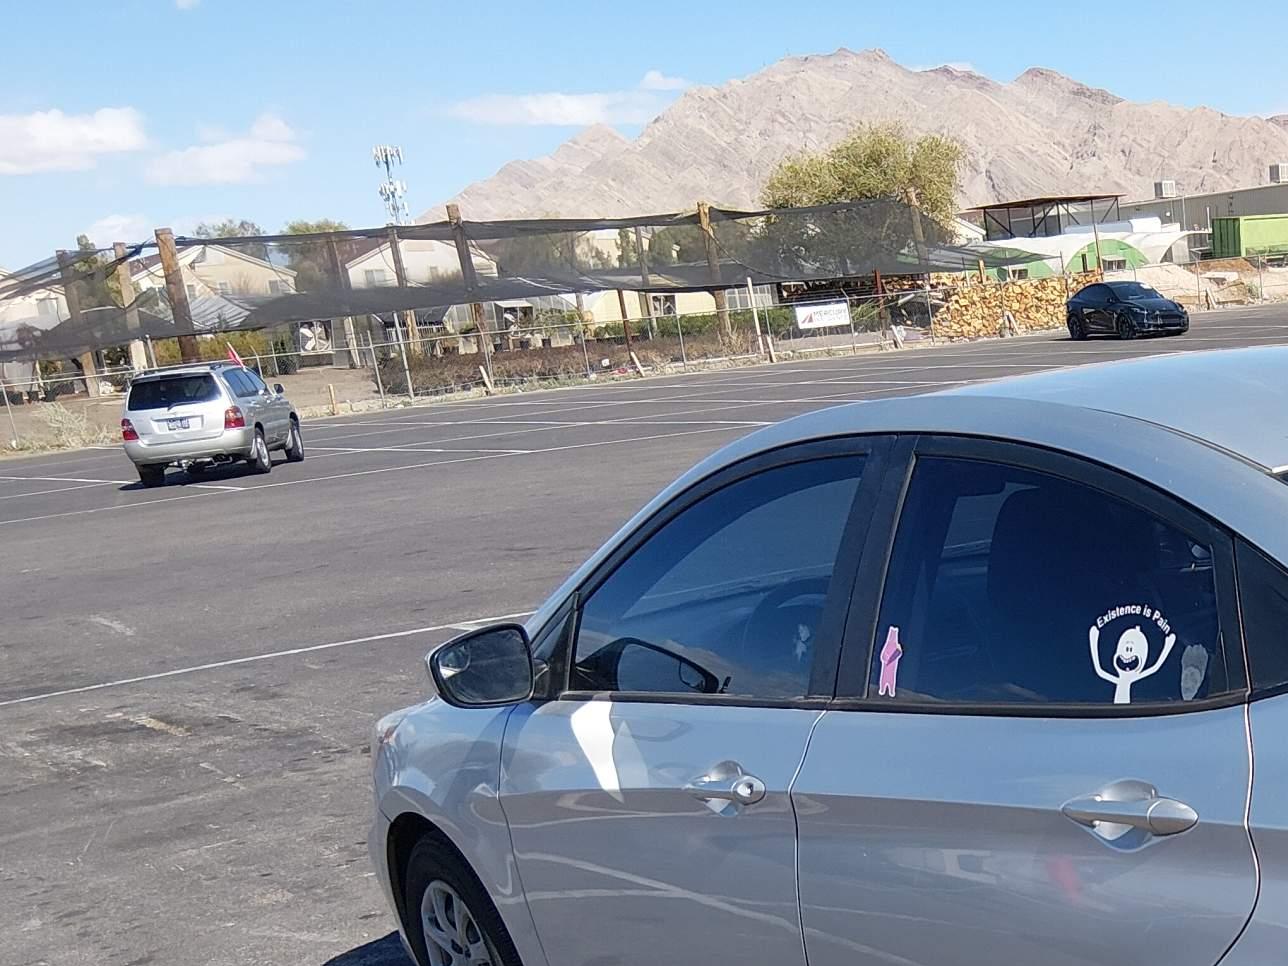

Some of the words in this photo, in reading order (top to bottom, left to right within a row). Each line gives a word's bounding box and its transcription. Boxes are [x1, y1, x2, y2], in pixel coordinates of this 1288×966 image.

[1096, 605, 1142, 629] Existence
[1142, 604, 1152, 618] is
[1152, 609, 1171, 635] Pain
